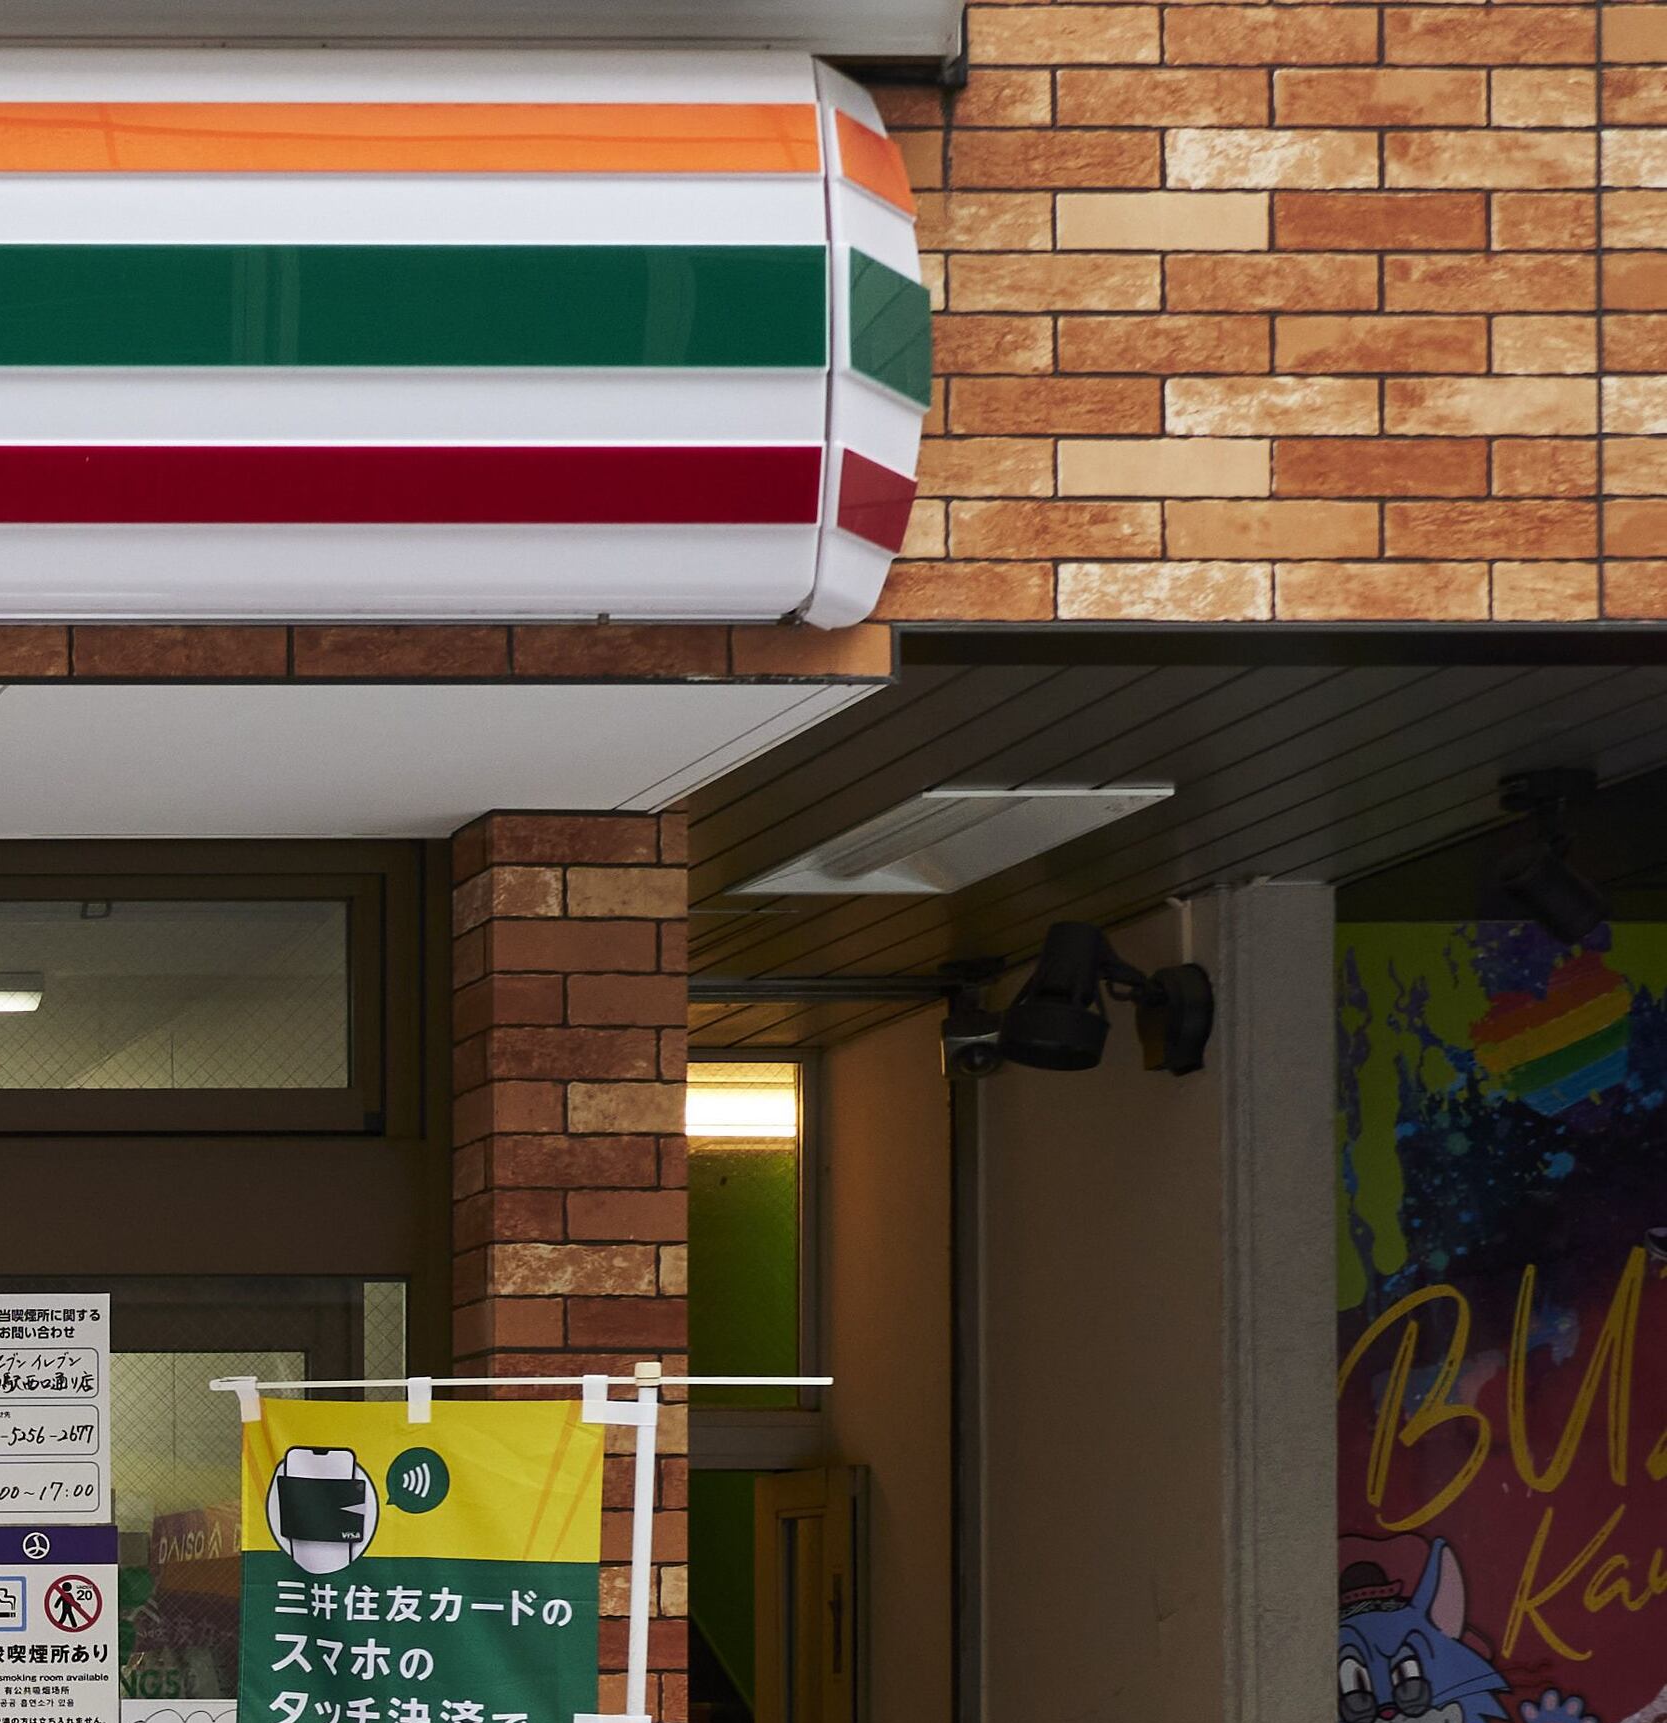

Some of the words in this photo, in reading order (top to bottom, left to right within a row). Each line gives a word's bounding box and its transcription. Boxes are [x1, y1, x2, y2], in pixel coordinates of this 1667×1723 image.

[1337, 1246, 1667, 1532] BU
[76, 1590, 93, 1601] 20
[274, 1580, 573, 1627] 三井住友カードの
[66, 1673, 109, 1682] available
[271, 1633, 434, 1680] スマホの
